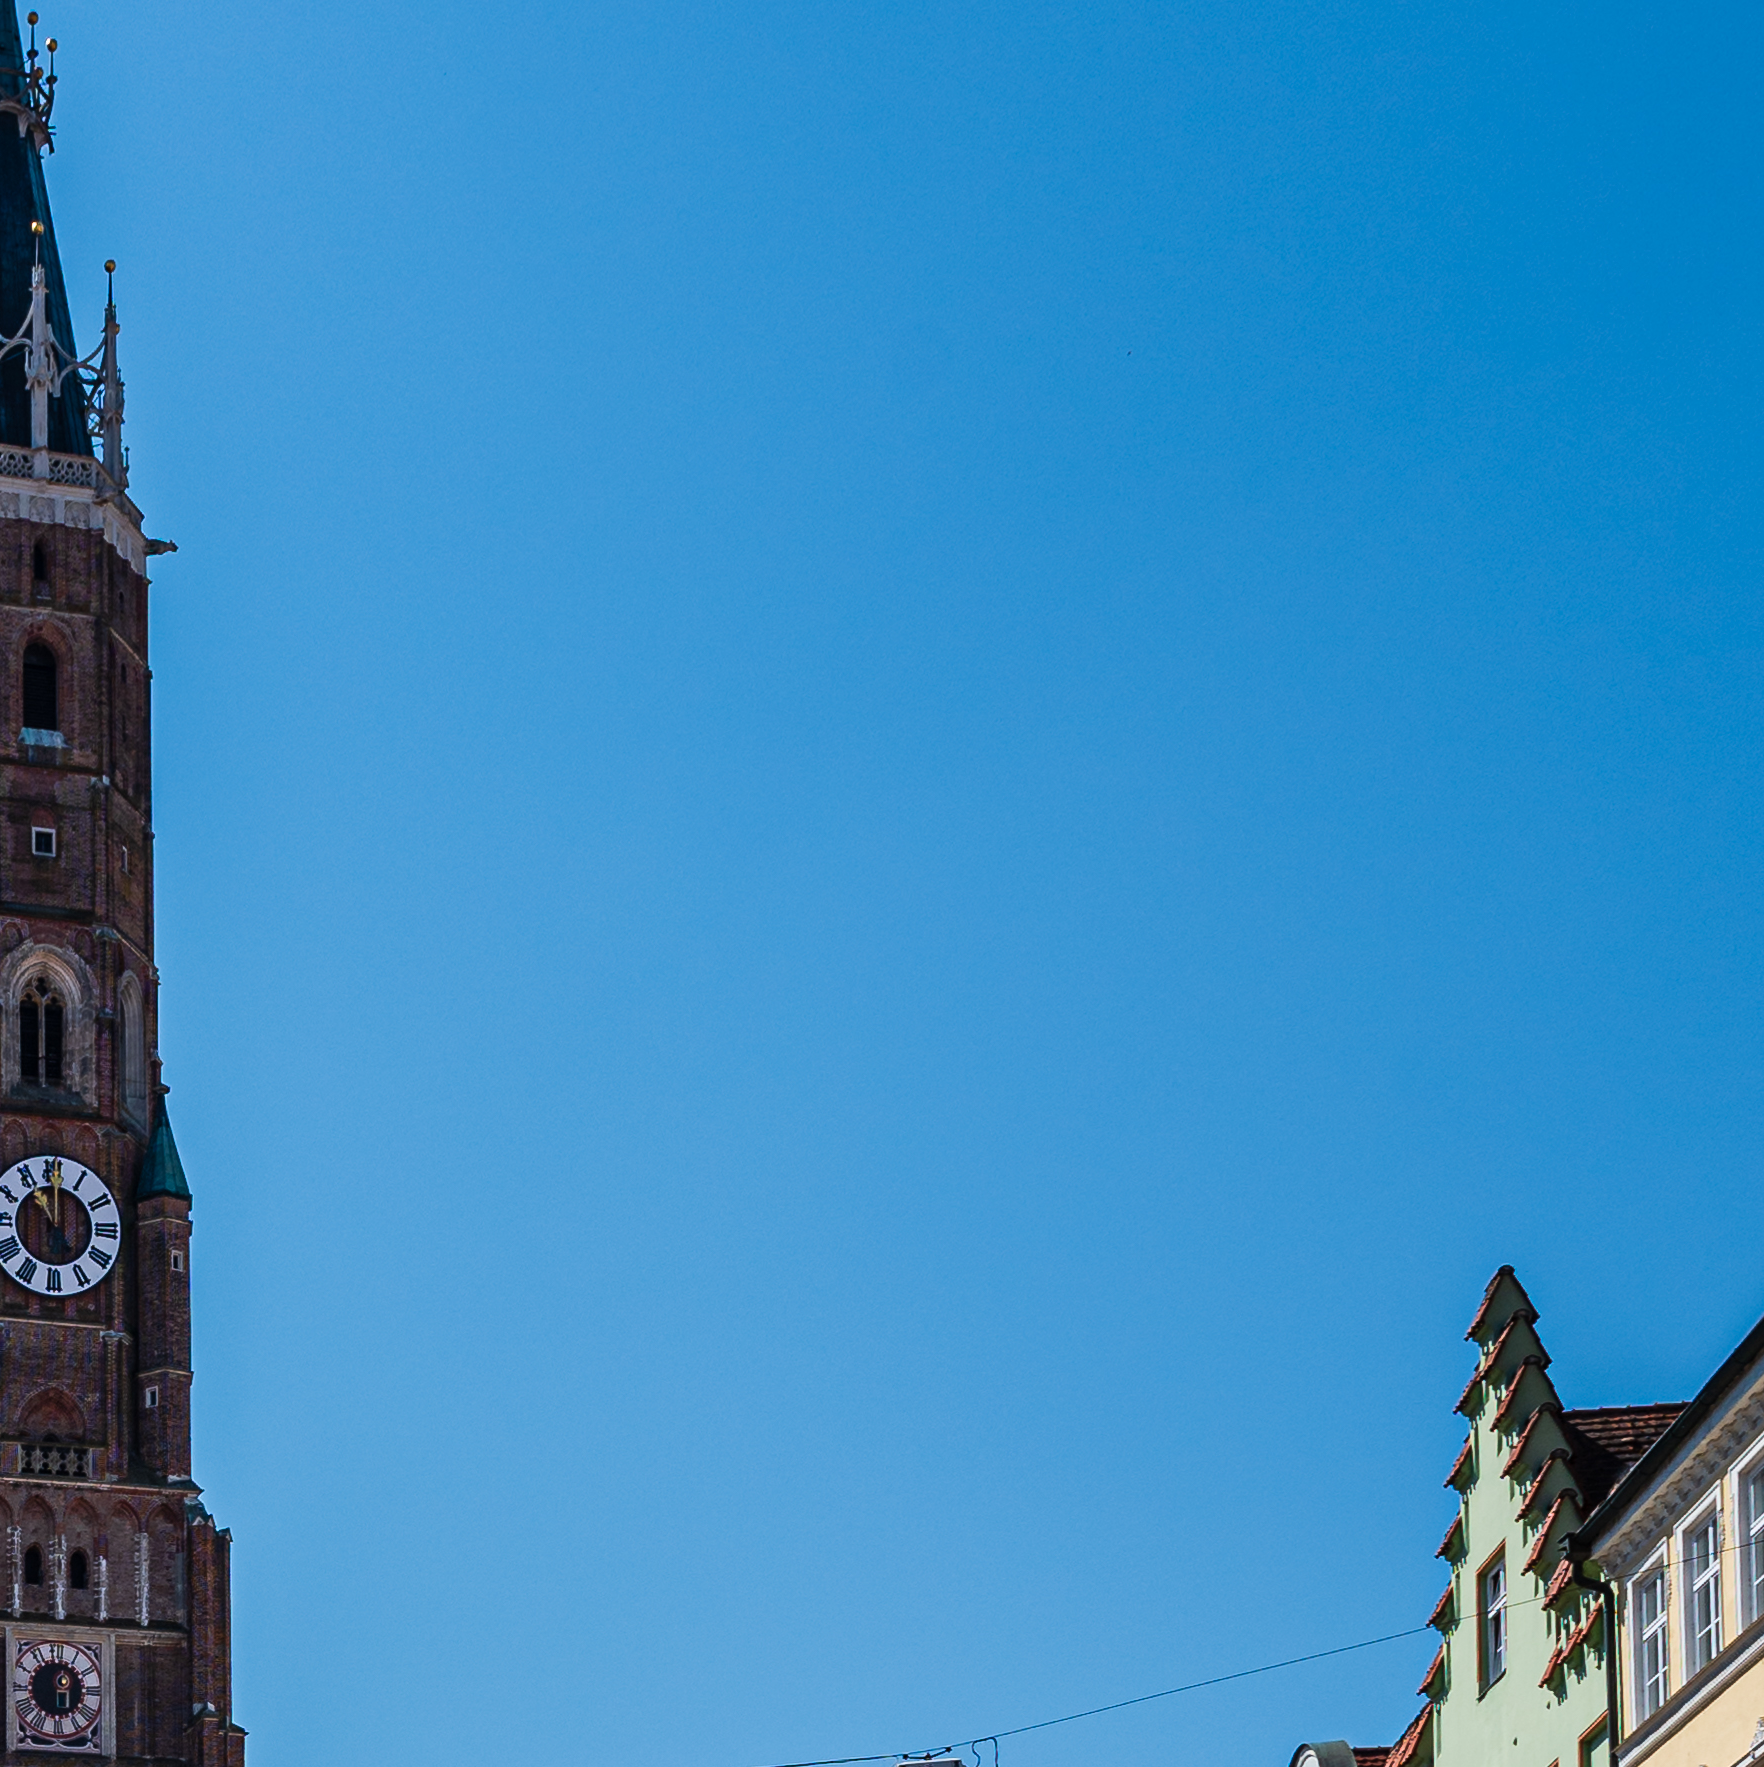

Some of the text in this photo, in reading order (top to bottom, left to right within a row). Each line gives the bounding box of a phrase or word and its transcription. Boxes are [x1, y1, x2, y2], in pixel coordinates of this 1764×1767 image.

[73, 1170, 88, 1192] I
[88, 1192, 111, 1212] II
[94, 1222, 119, 1240] III
